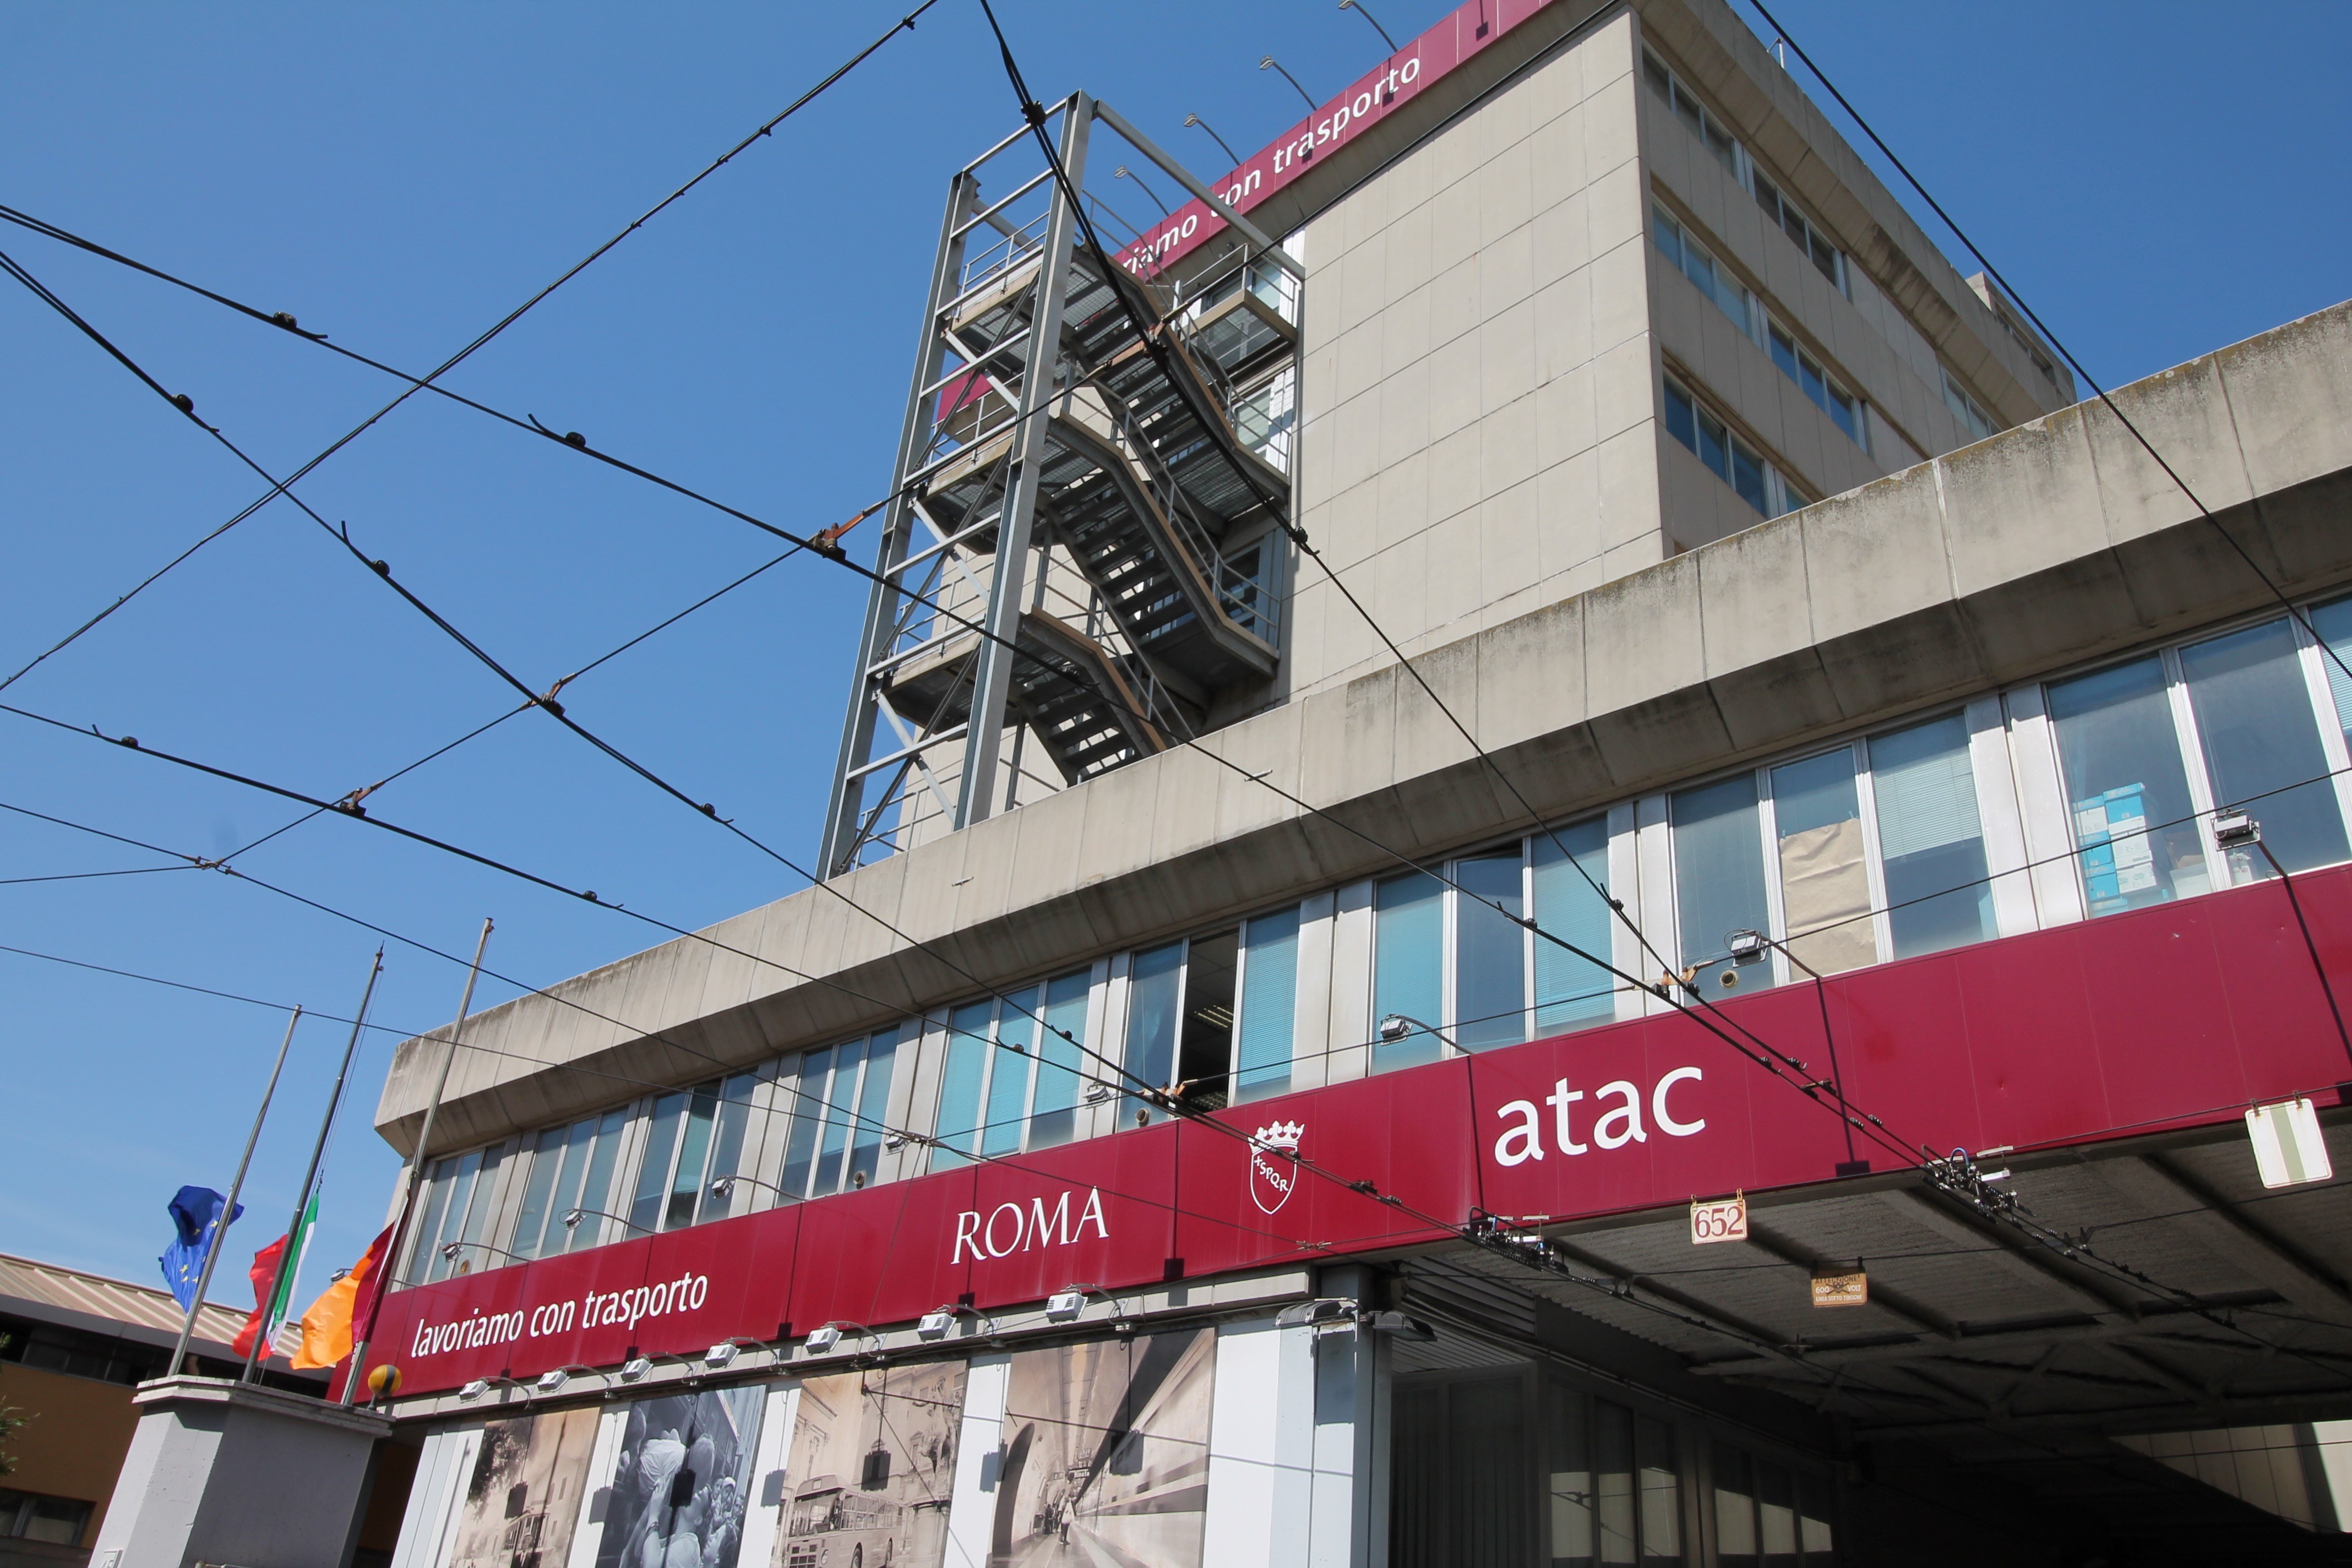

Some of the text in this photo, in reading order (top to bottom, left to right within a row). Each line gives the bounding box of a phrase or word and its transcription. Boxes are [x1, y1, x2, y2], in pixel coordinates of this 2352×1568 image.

[1273, 57, 1420, 174] trasporto
[1495, 1066, 1706, 1167] atac
[1259, 1162, 1289, 1192] SPQR
[951, 1185, 1110, 1265] ROMA
[1695, 1206, 1744, 1238] 652
[411, 1272, 708, 1358] lavoriamo con trasporto
